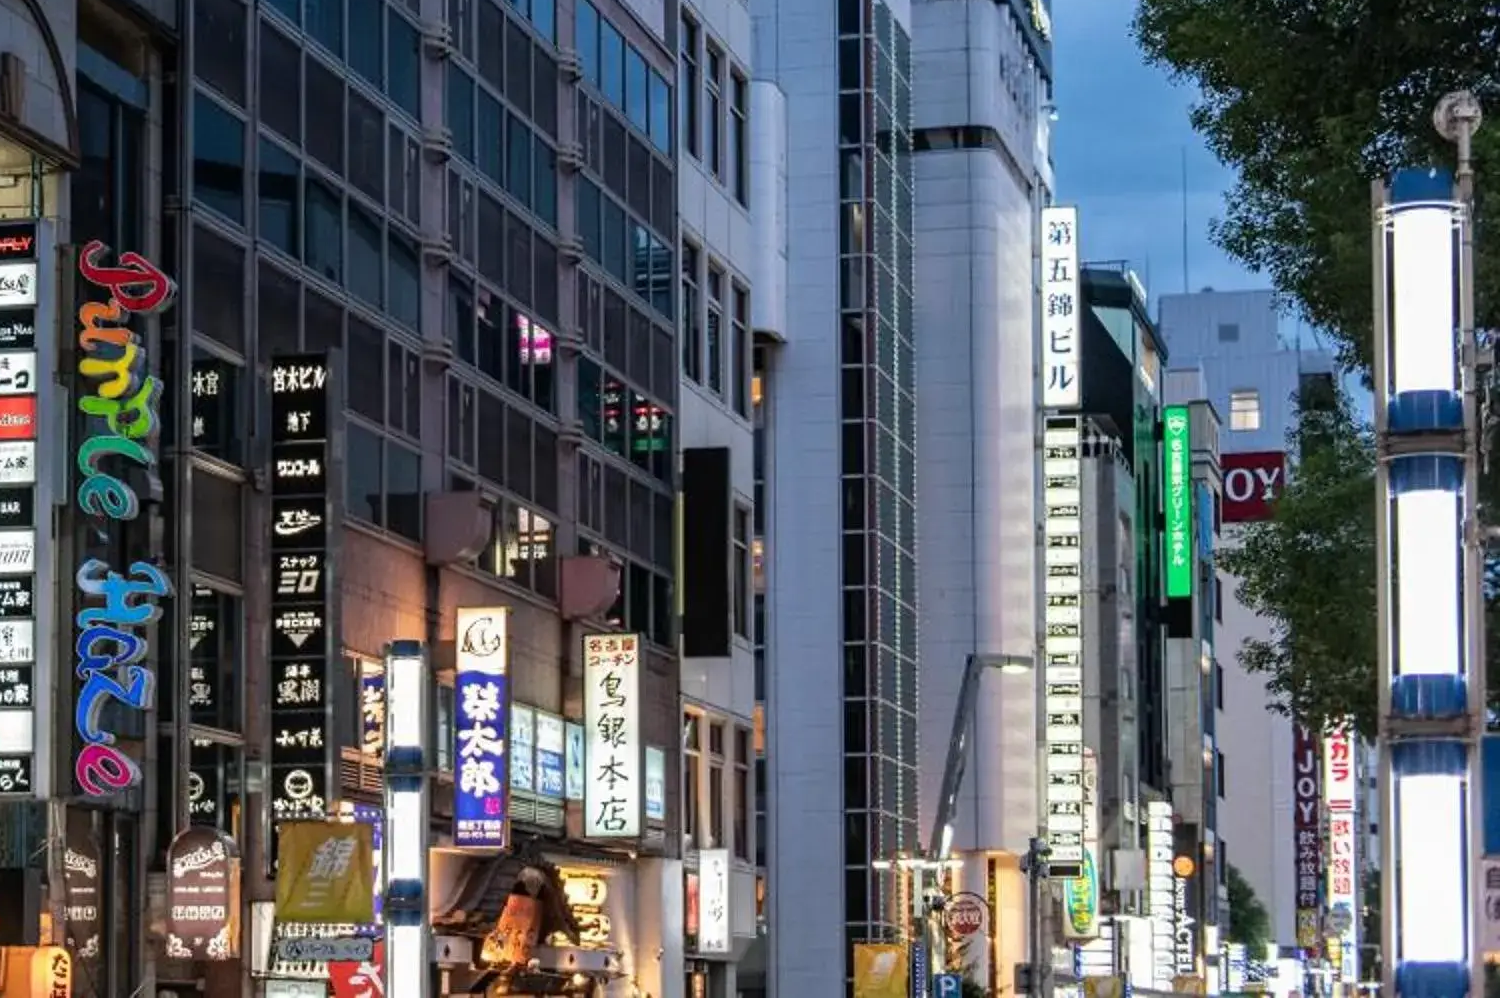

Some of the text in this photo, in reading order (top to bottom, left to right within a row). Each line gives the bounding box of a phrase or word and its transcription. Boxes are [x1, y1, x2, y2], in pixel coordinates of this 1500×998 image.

[1047, 221, 1074, 391] 第五錦ビル
[272, 366, 327, 393] 宮木ビル
